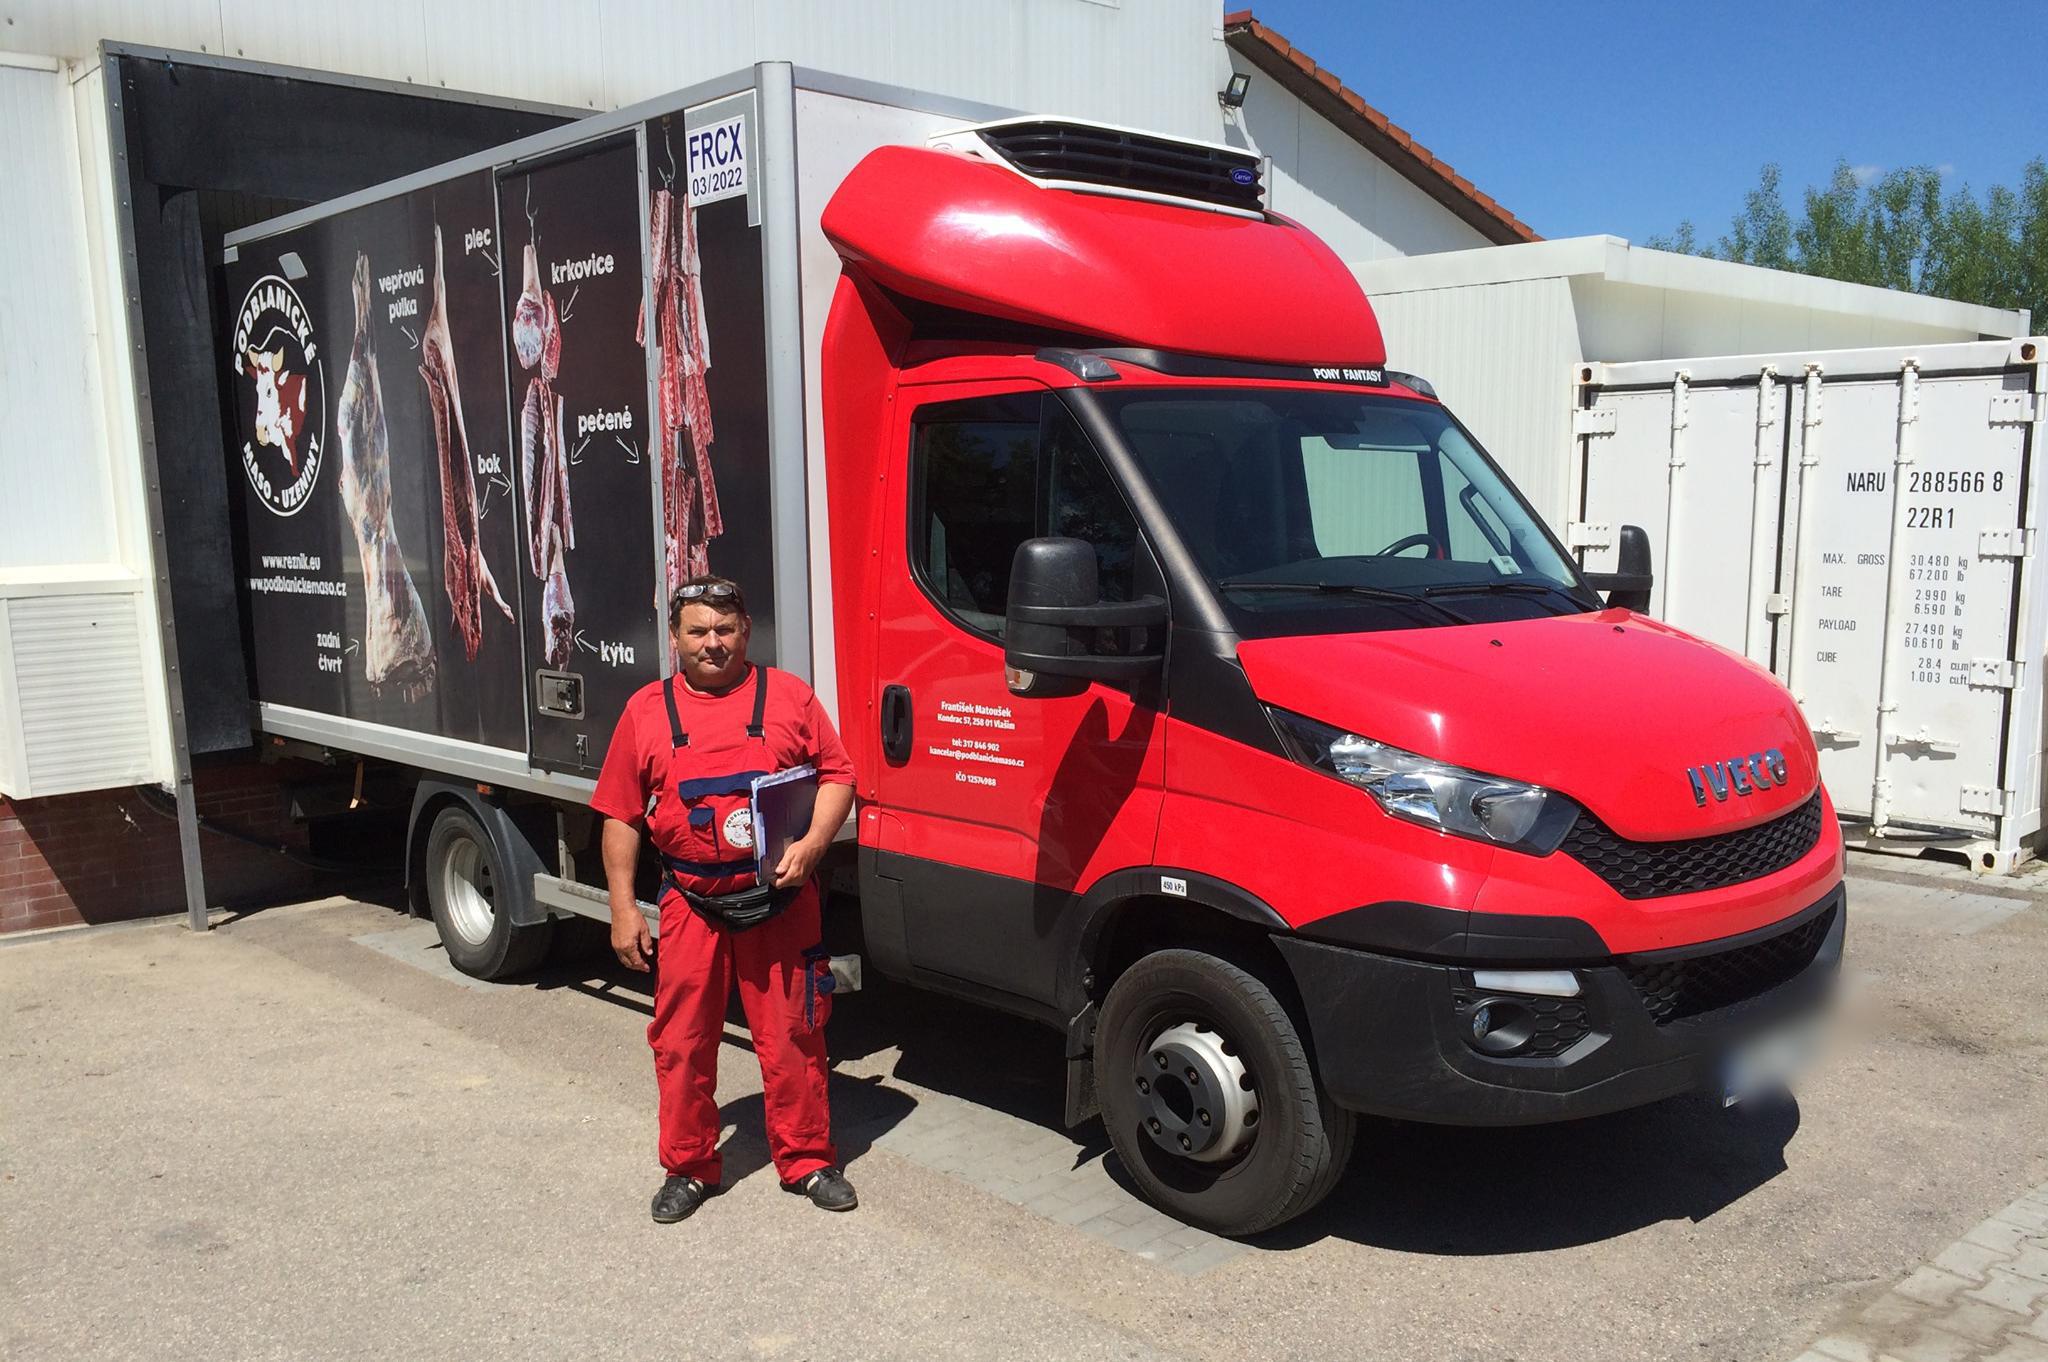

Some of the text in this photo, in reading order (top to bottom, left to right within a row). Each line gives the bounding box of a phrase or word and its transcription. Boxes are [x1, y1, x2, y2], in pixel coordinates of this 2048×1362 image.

[688, 122, 743, 173] FRCX
[692, 166, 743, 197] 03/2022
[464, 227, 492, 256] plec
[378, 263, 425, 295] vepřová
[551, 252, 615, 285] krkovice
[234, 284, 317, 377] PODBLANICKÉ
[1312, 367, 1383, 382] PONY FANTASY
[243, 441, 272, 500] MASO
[281, 432, 319, 509] UZENINY
[477, 453, 502, 475] bok
[1846, 470, 2004, 493] NARU 288566 8
[1906, 507, 1955, 529] 22R1
[262, 552, 321, 571] www.reznik.eu
[1822, 552, 1969, 571] MAX. GROSS 30.480 kg
[1956, 570, 1965, 582] lb
[1821, 585, 1843, 598] TARE
[1955, 590, 1966, 606] kg
[1913, 603, 1962, 617] 6.590 lb
[1818, 618, 1857, 631] PAYLOAD
[1952, 624, 1963, 640] kg
[600, 640, 635, 668] kýta
[1951, 639, 1960, 651] lb
[1816, 651, 1838, 663] CUBE
[1918, 657, 1942, 670] 28.4
[1911, 670, 1941, 684] 1.003
[941, 701, 1012, 718] František Matoušek
[985, 719, 993, 728] 01
[1687, 748, 1788, 807] IVECO
